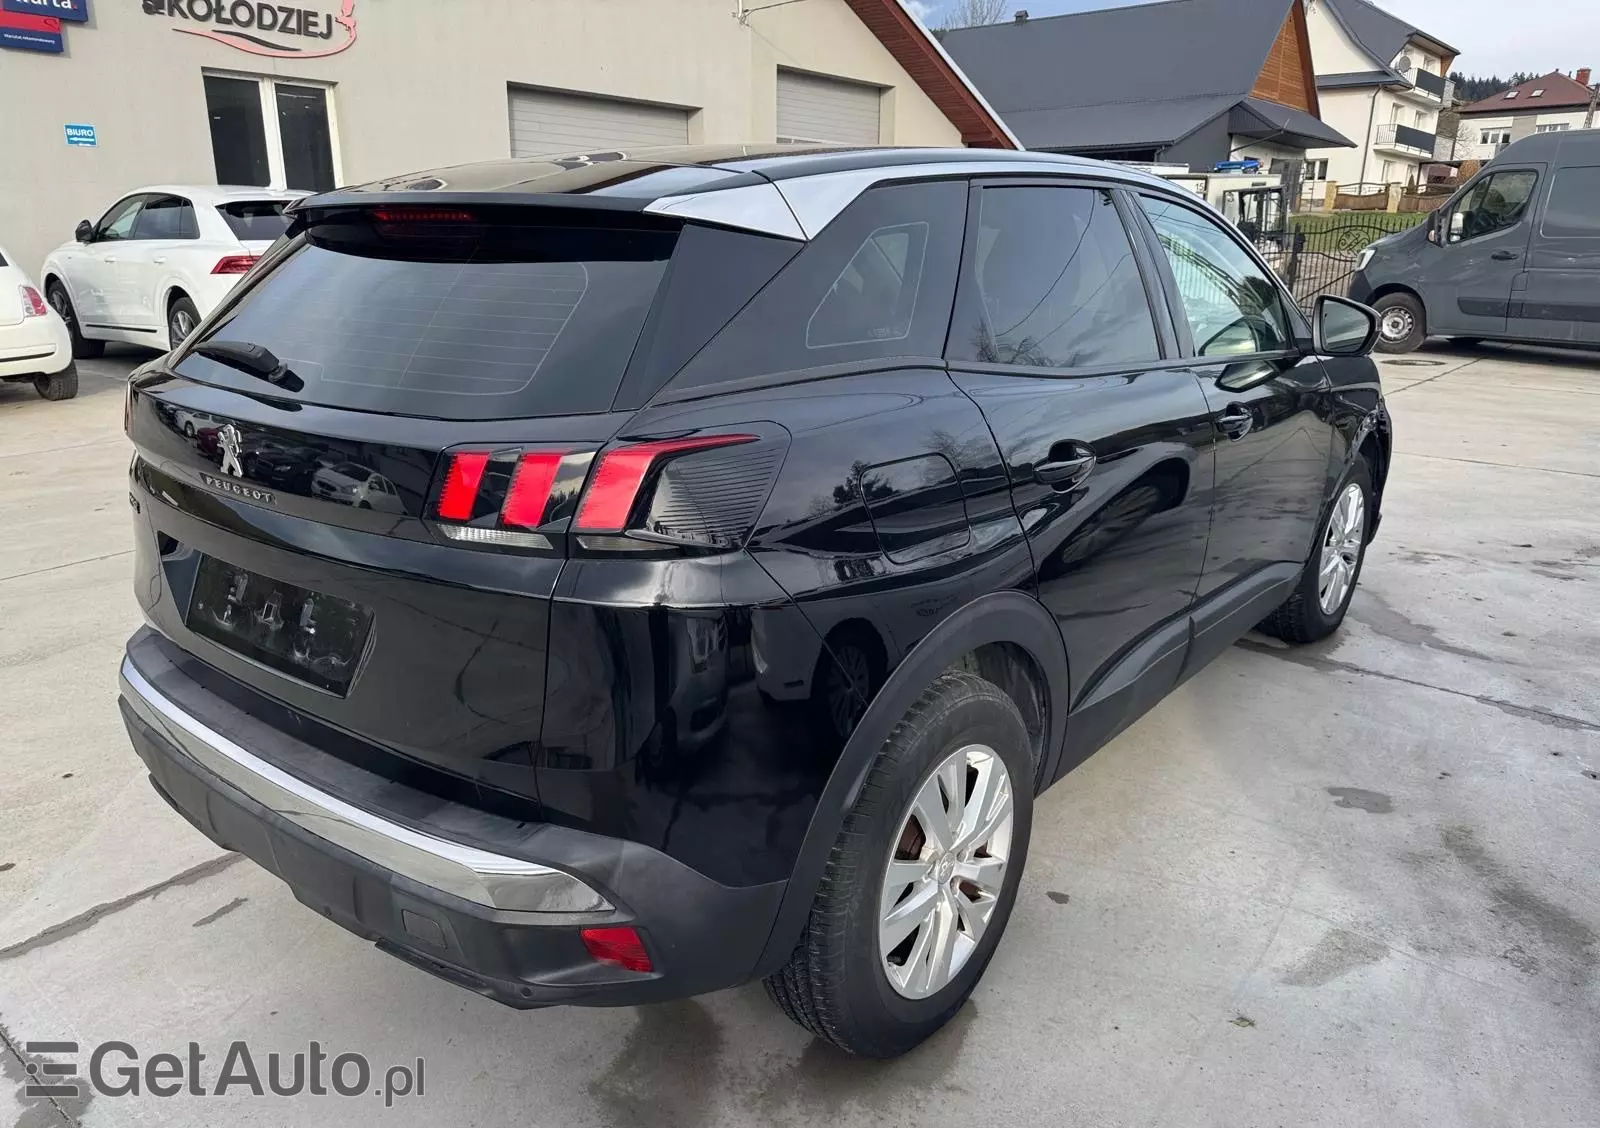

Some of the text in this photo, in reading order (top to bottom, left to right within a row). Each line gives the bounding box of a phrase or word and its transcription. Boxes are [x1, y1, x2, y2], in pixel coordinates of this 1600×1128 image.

[167, 0, 332, 39] KOŁODZIEJ
[66, 128, 94, 137] BIURO
[205, 476, 271, 503] PEUGEOT
